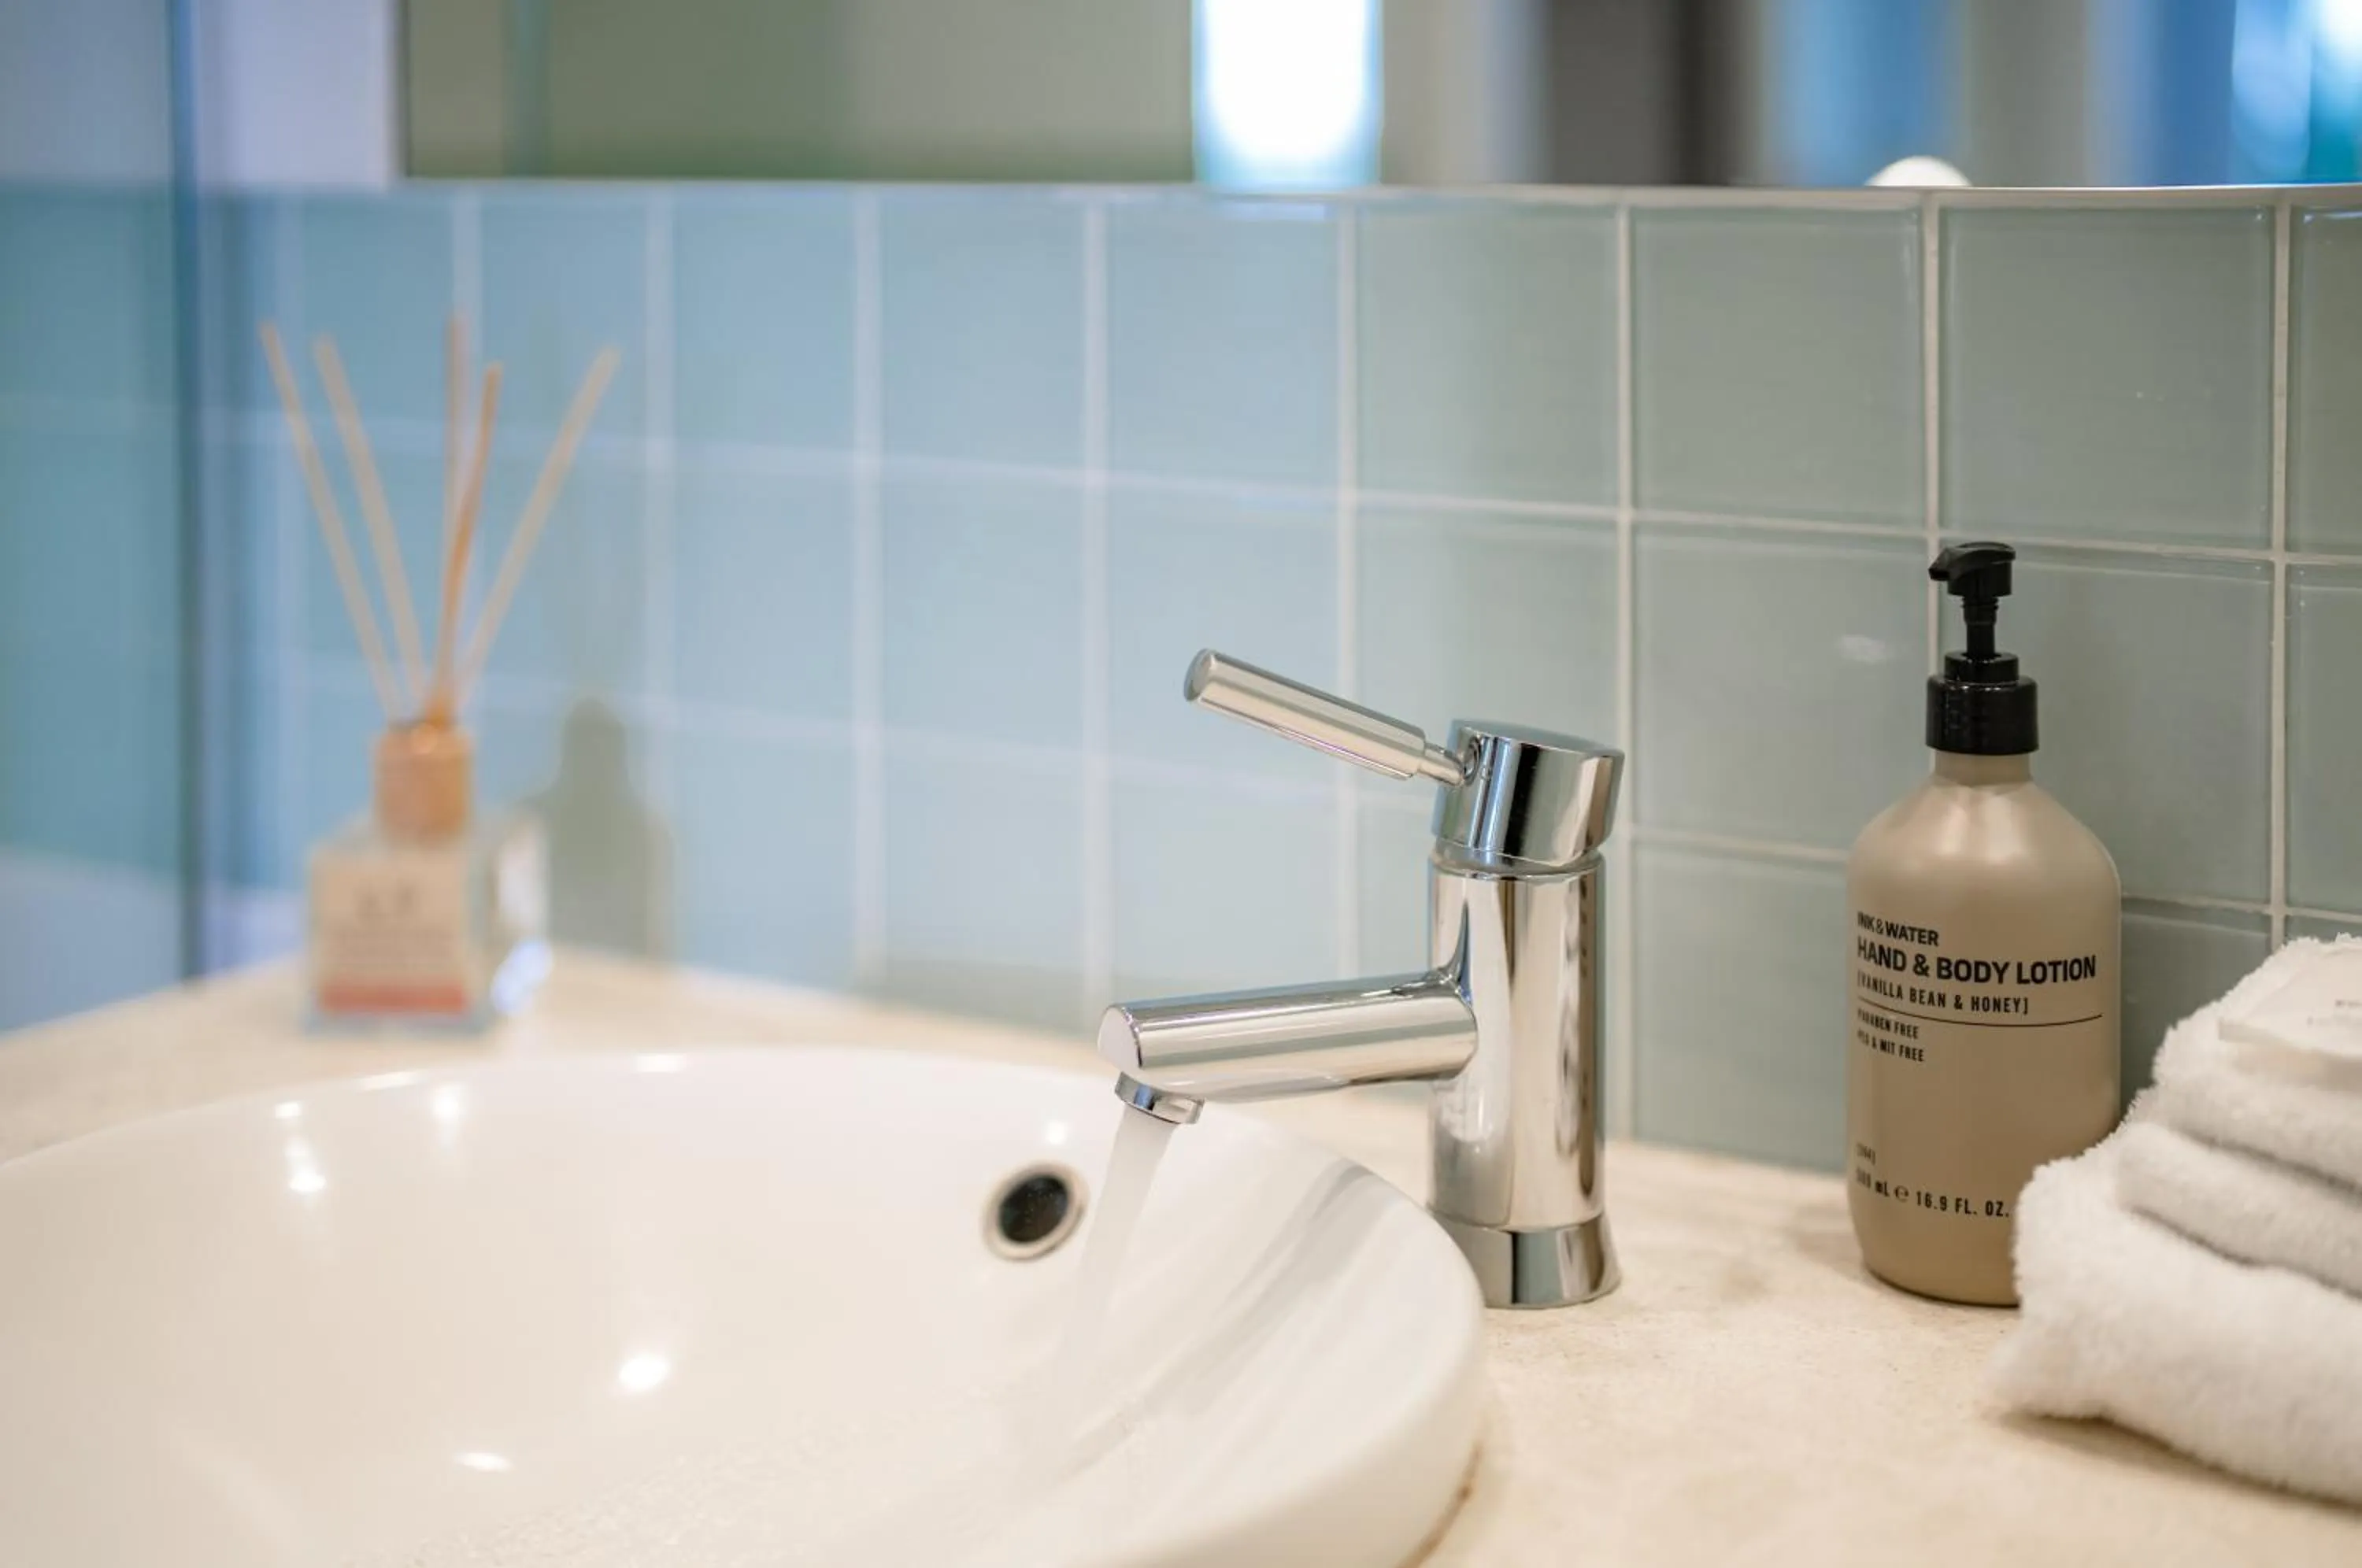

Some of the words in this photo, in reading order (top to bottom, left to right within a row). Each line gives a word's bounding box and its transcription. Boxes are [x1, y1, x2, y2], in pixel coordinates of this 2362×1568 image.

[1857, 935, 1906, 972] HAND
[1913, 953, 1931, 977] &
[1936, 957, 2010, 984] BODY
[2016, 955, 2097, 985] LOTION
[1909, 987, 1946, 1008] BEAN
[1953, 994, 1964, 1011] &
[1971, 995, 2029, 1015] HONEY]
[1894, 1021, 1920, 1039] FREE
[1899, 1045, 1925, 1062] FREE
[1916, 1190, 1948, 1211] 16.9
[1955, 1197, 1978, 1215] FL.
[1985, 1200, 2009, 1218] OZ.
